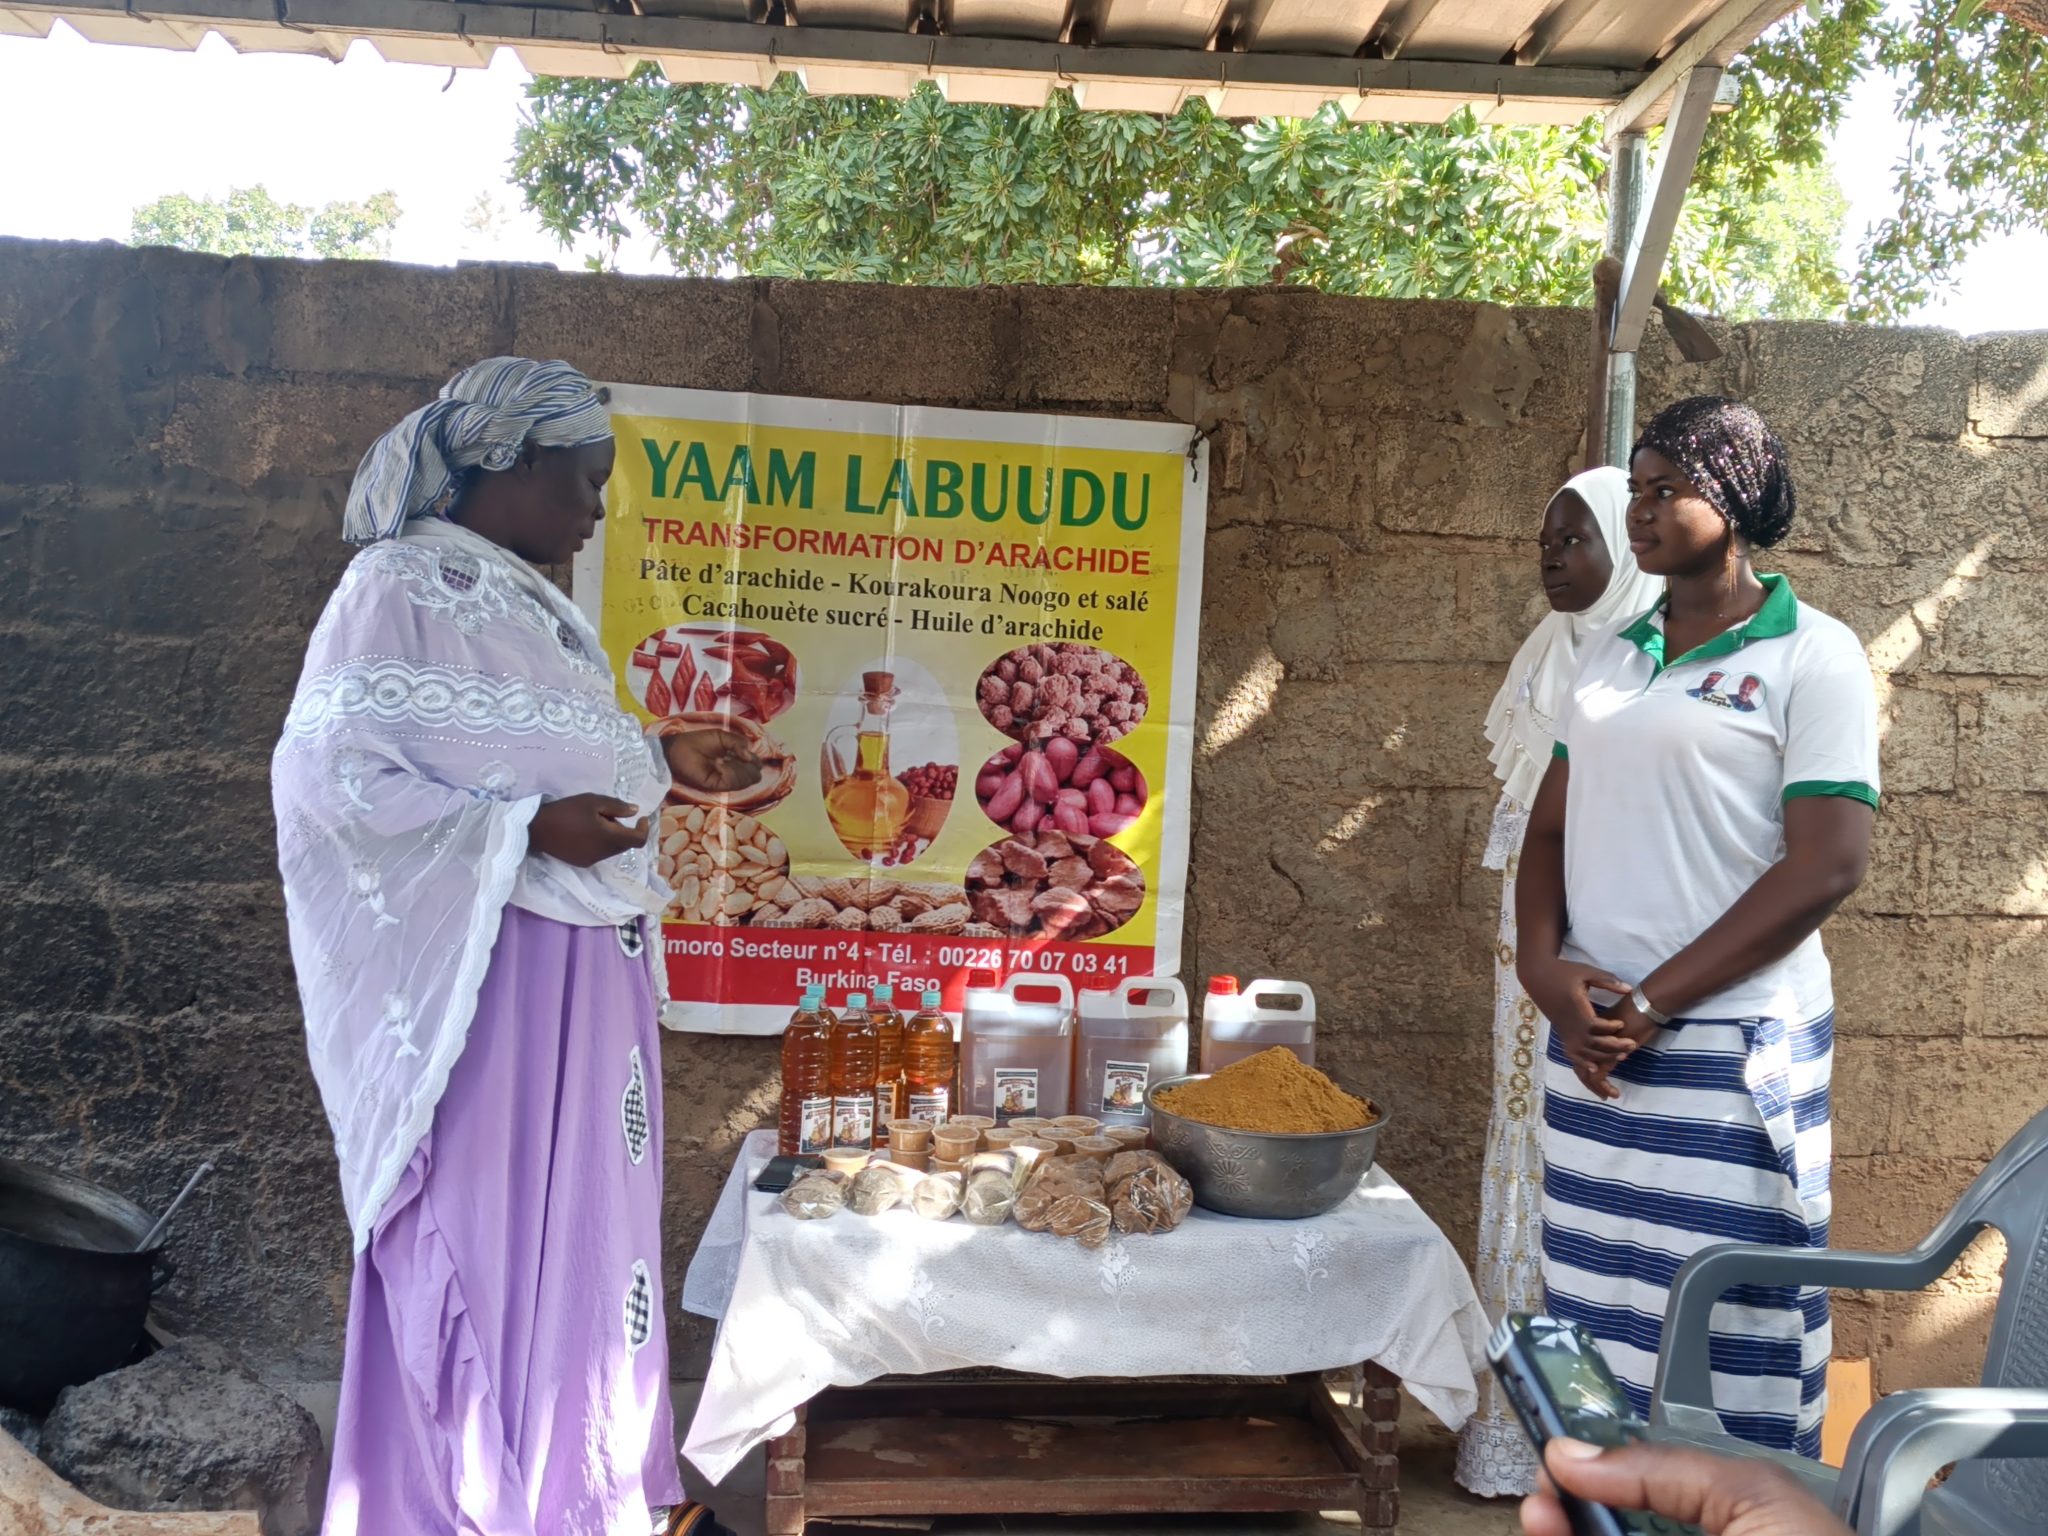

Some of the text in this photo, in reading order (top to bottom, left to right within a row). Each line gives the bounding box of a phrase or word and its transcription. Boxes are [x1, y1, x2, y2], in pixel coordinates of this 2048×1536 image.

[641, 438, 1151, 531] YAAM LABUUDU
[642, 518, 1151, 576] TRANSFORMATION D’ARACHIDE
[639, 558, 691, 583] Pâte
[698, 563, 824, 591] d’arachide
[849, 573, 991, 603] Kourakoura
[1000, 583, 1070, 612] Noogo
[1078, 589, 1099, 609] et
[1105, 591, 1149, 612] salé
[682, 594, 819, 624] Cacahouète
[826, 607, 888, 628] sucré
[911, 609, 973, 634] Huile
[981, 614, 1104, 641] d’arachide
[662, 934, 724, 956] imoro
[730, 937, 817, 960] Secteur
[824, 941, 859, 961] n°4
[878, 943, 917, 965] Tél.
[939, 946, 1002, 968] 00226
[1008, 949, 1033, 970] 70
[1040, 951, 1065, 971] 07
[1072, 953, 1097, 972] 03
[1103, 955, 1128, 974] 41
[796, 968, 941, 993] Burkina Faso
